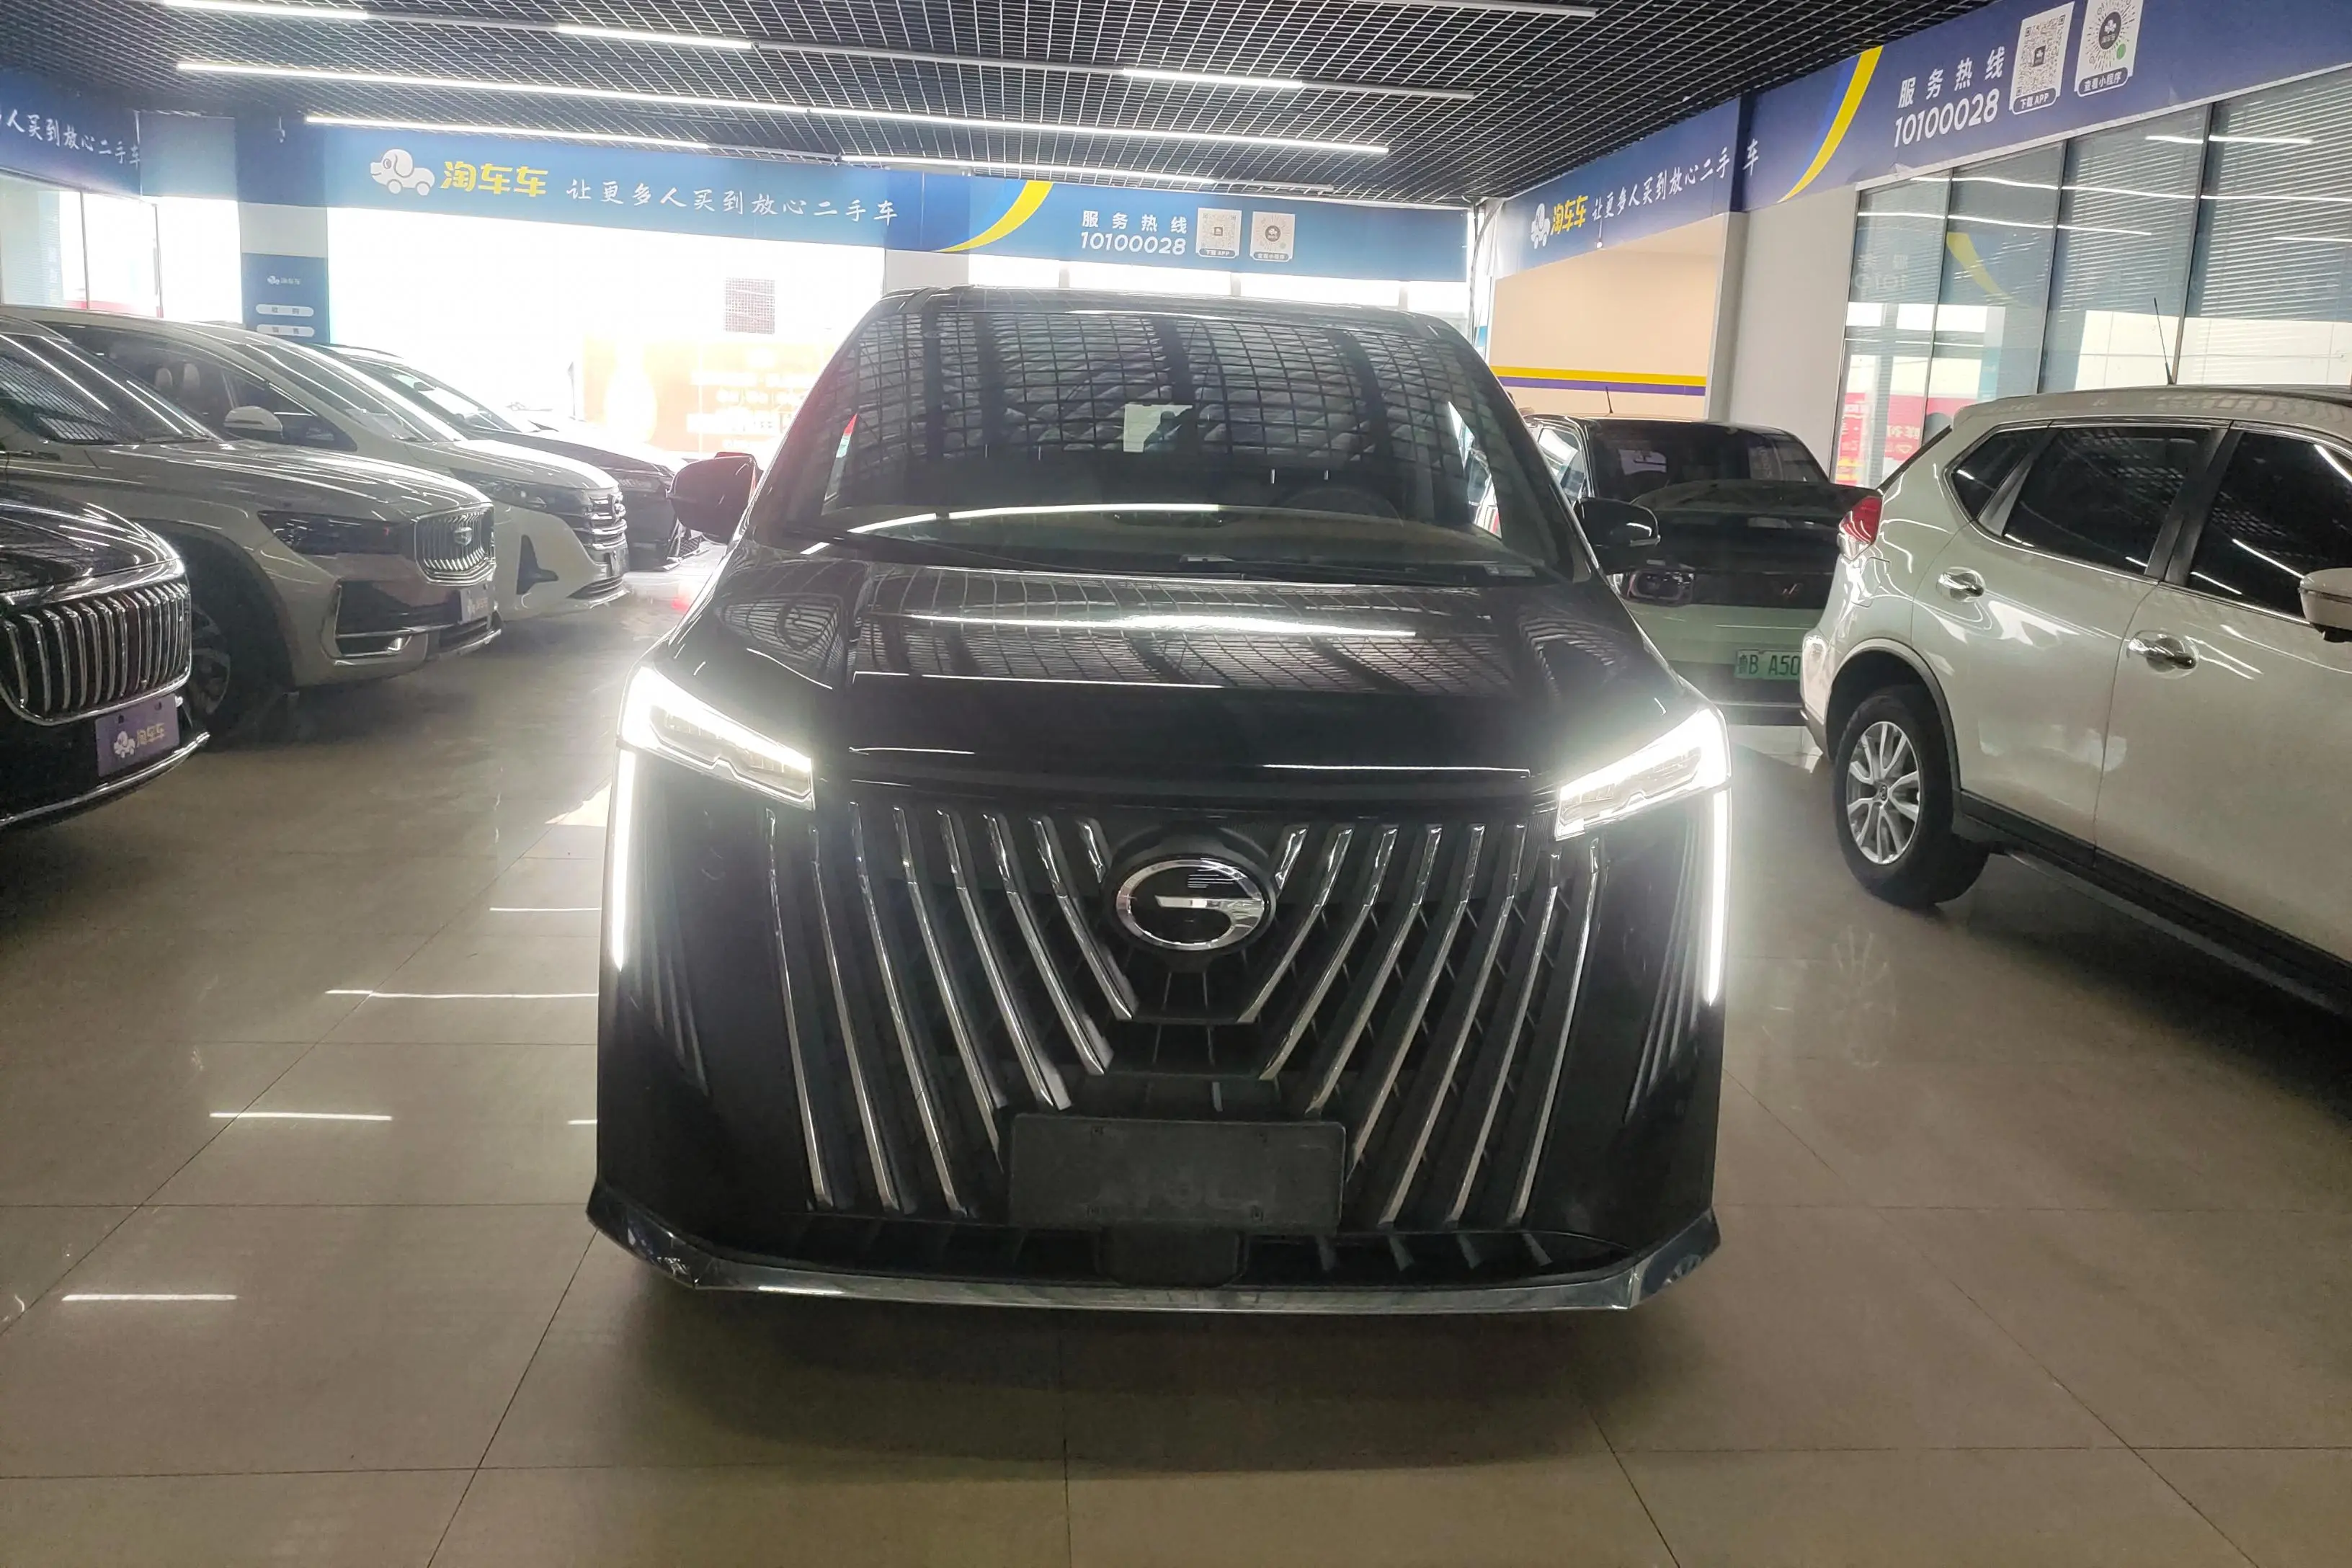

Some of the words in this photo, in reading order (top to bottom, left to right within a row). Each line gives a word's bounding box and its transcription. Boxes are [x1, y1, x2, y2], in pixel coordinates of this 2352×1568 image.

[1898, 46, 2006, 109] 服务热线
[2034, 93, 2049, 105] APP
[0, 109, 141, 170] 人买到放心二手车
[1894, 89, 2000, 148] 10100028
[439, 161, 549, 197] 淘车车
[566, 178, 899, 227] 让更多人买到放心二手车
[1551, 195, 1589, 236] 淘车车
[1592, 138, 1760, 221] 让更多人买到放心二手车
[1080, 231, 1187, 256] 10100028
[1082, 210, 1188, 234] 服务热线
